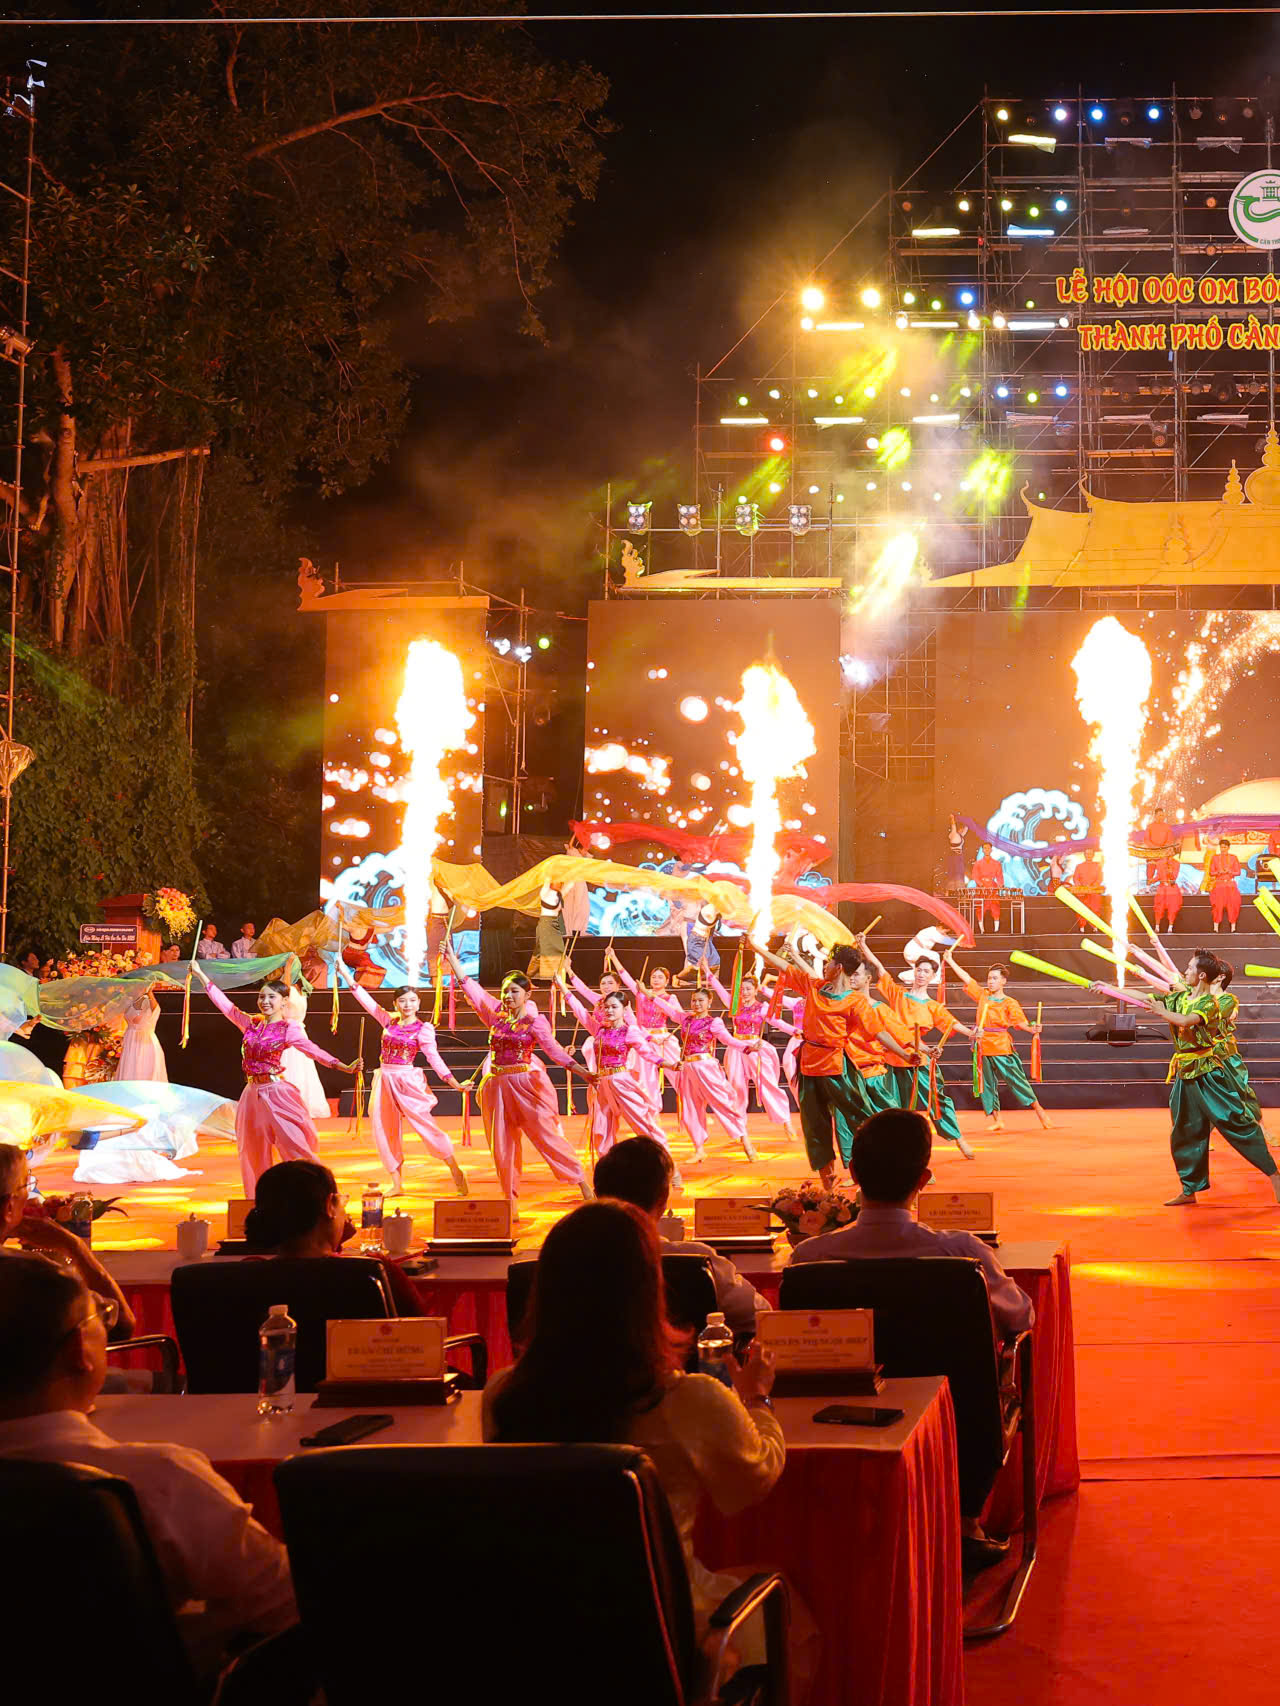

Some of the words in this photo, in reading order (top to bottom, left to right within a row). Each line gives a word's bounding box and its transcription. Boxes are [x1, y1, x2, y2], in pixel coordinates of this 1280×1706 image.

[1056, 268, 1088, 303] LỄ
[1094, 273, 1138, 307] HỘI
[1142, 273, 1194, 304] OÓC
[1199, 277, 1239, 304] OM
[1077, 320, 1166, 350] THÀNH
[1170, 314, 1223, 350] PHỐ
[1227, 314, 1280, 350] CẦN
